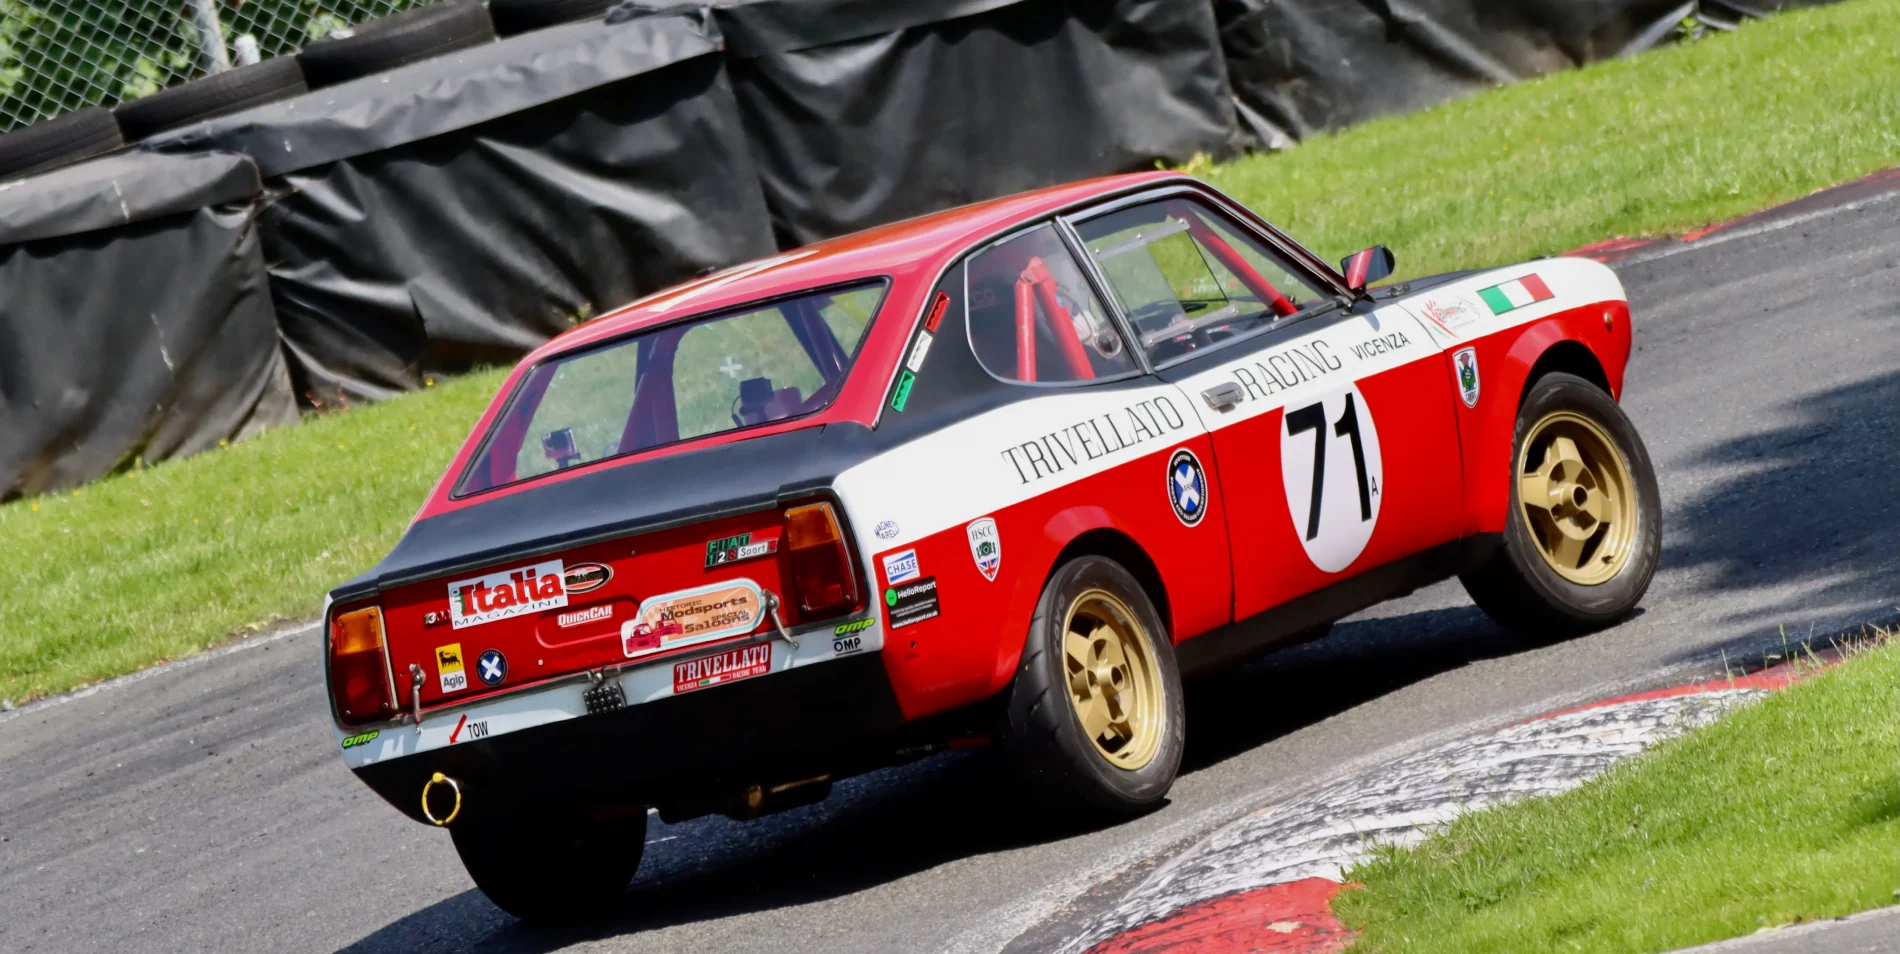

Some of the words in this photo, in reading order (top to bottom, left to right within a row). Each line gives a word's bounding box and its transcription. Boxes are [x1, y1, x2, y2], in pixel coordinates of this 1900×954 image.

[1001, 396, 1184, 485] TRIVELLATO
[1232, 339, 1342, 401] RACING
[1349, 331, 1411, 361] VICENZA
[1285, 392, 1372, 542] 71
[1371, 475, 1379, 497] A
[971, 525, 994, 541] HSCC
[709, 534, 749, 552] FIAT
[708, 549, 737, 565] 128
[741, 545, 765, 557] Sport
[887, 558, 917, 575] CHASE
[459, 568, 564, 617] Italia
[897, 581, 937, 599] HelloReport
[660, 600, 702, 612] HISTORIC
[660, 597, 748, 621] Modsports
[684, 616, 749, 633] Saloons
[834, 637, 861, 652] OMP
[676, 644, 769, 683] TRIVELLATO
[752, 665, 767, 675] TEAM
[443, 675, 465, 688] Agip
[467, 720, 489, 738] TOW
